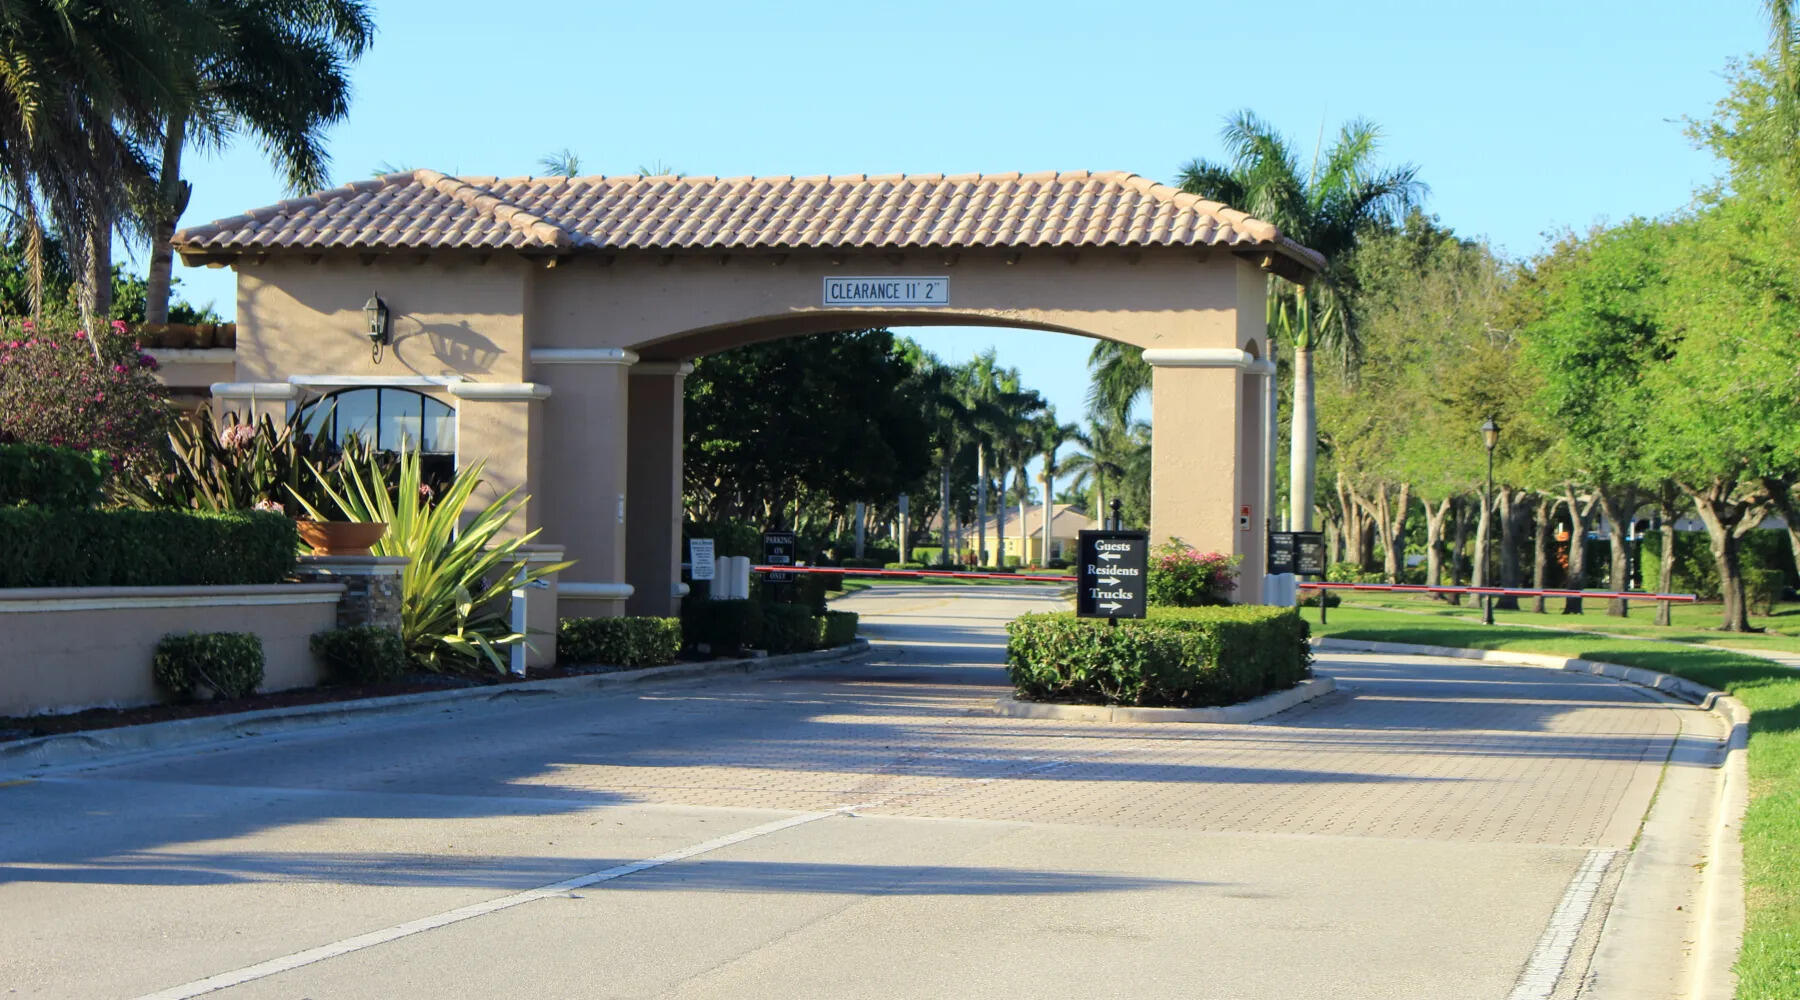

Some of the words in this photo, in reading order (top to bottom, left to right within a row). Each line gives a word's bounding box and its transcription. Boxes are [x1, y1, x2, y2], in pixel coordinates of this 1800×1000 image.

[831, 283, 900, 299] CLEARANCE
[906, 283, 920, 299] 11'
[1095, 540, 1131, 552] Guests
[1087, 564, 1139, 576] Residents
[1089, 588, 1133, 600] Trucks
